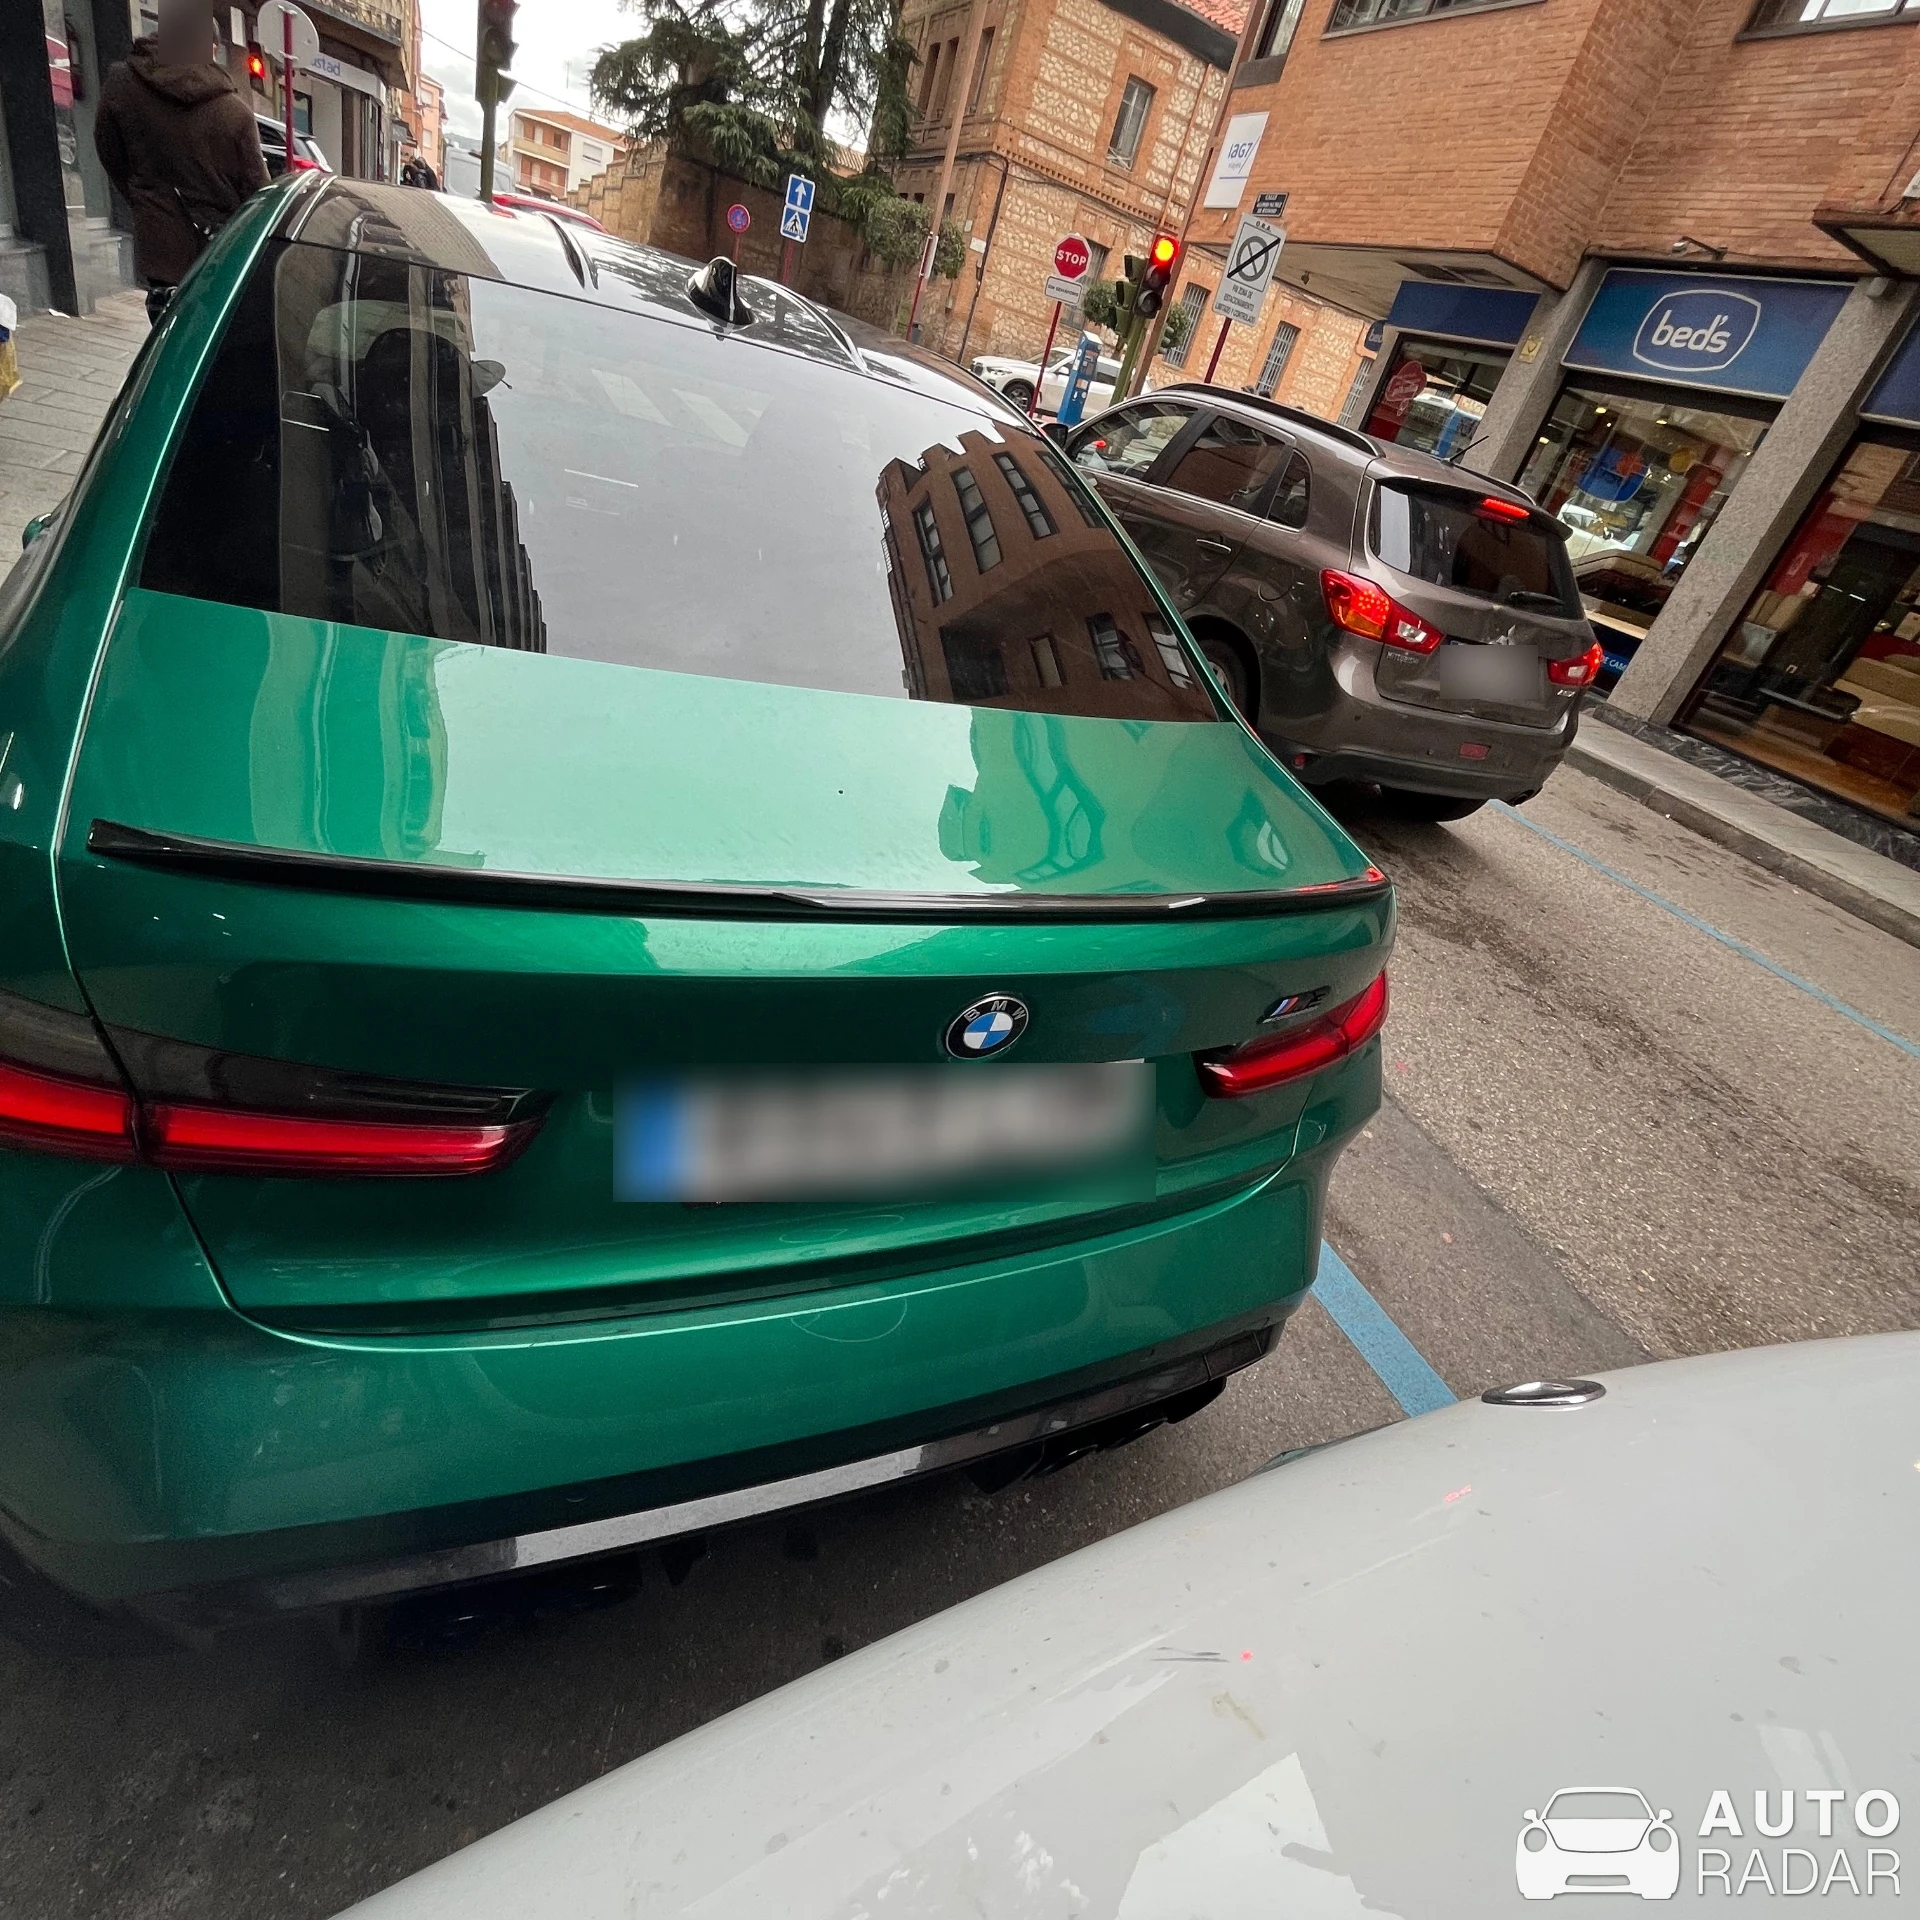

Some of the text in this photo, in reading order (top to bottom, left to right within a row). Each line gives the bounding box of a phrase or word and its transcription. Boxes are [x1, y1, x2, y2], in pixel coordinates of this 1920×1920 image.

[1056, 249, 1087, 267] STOP
[1651, 309, 1732, 353] bed's
[963, 1000, 1026, 1022] BMW
